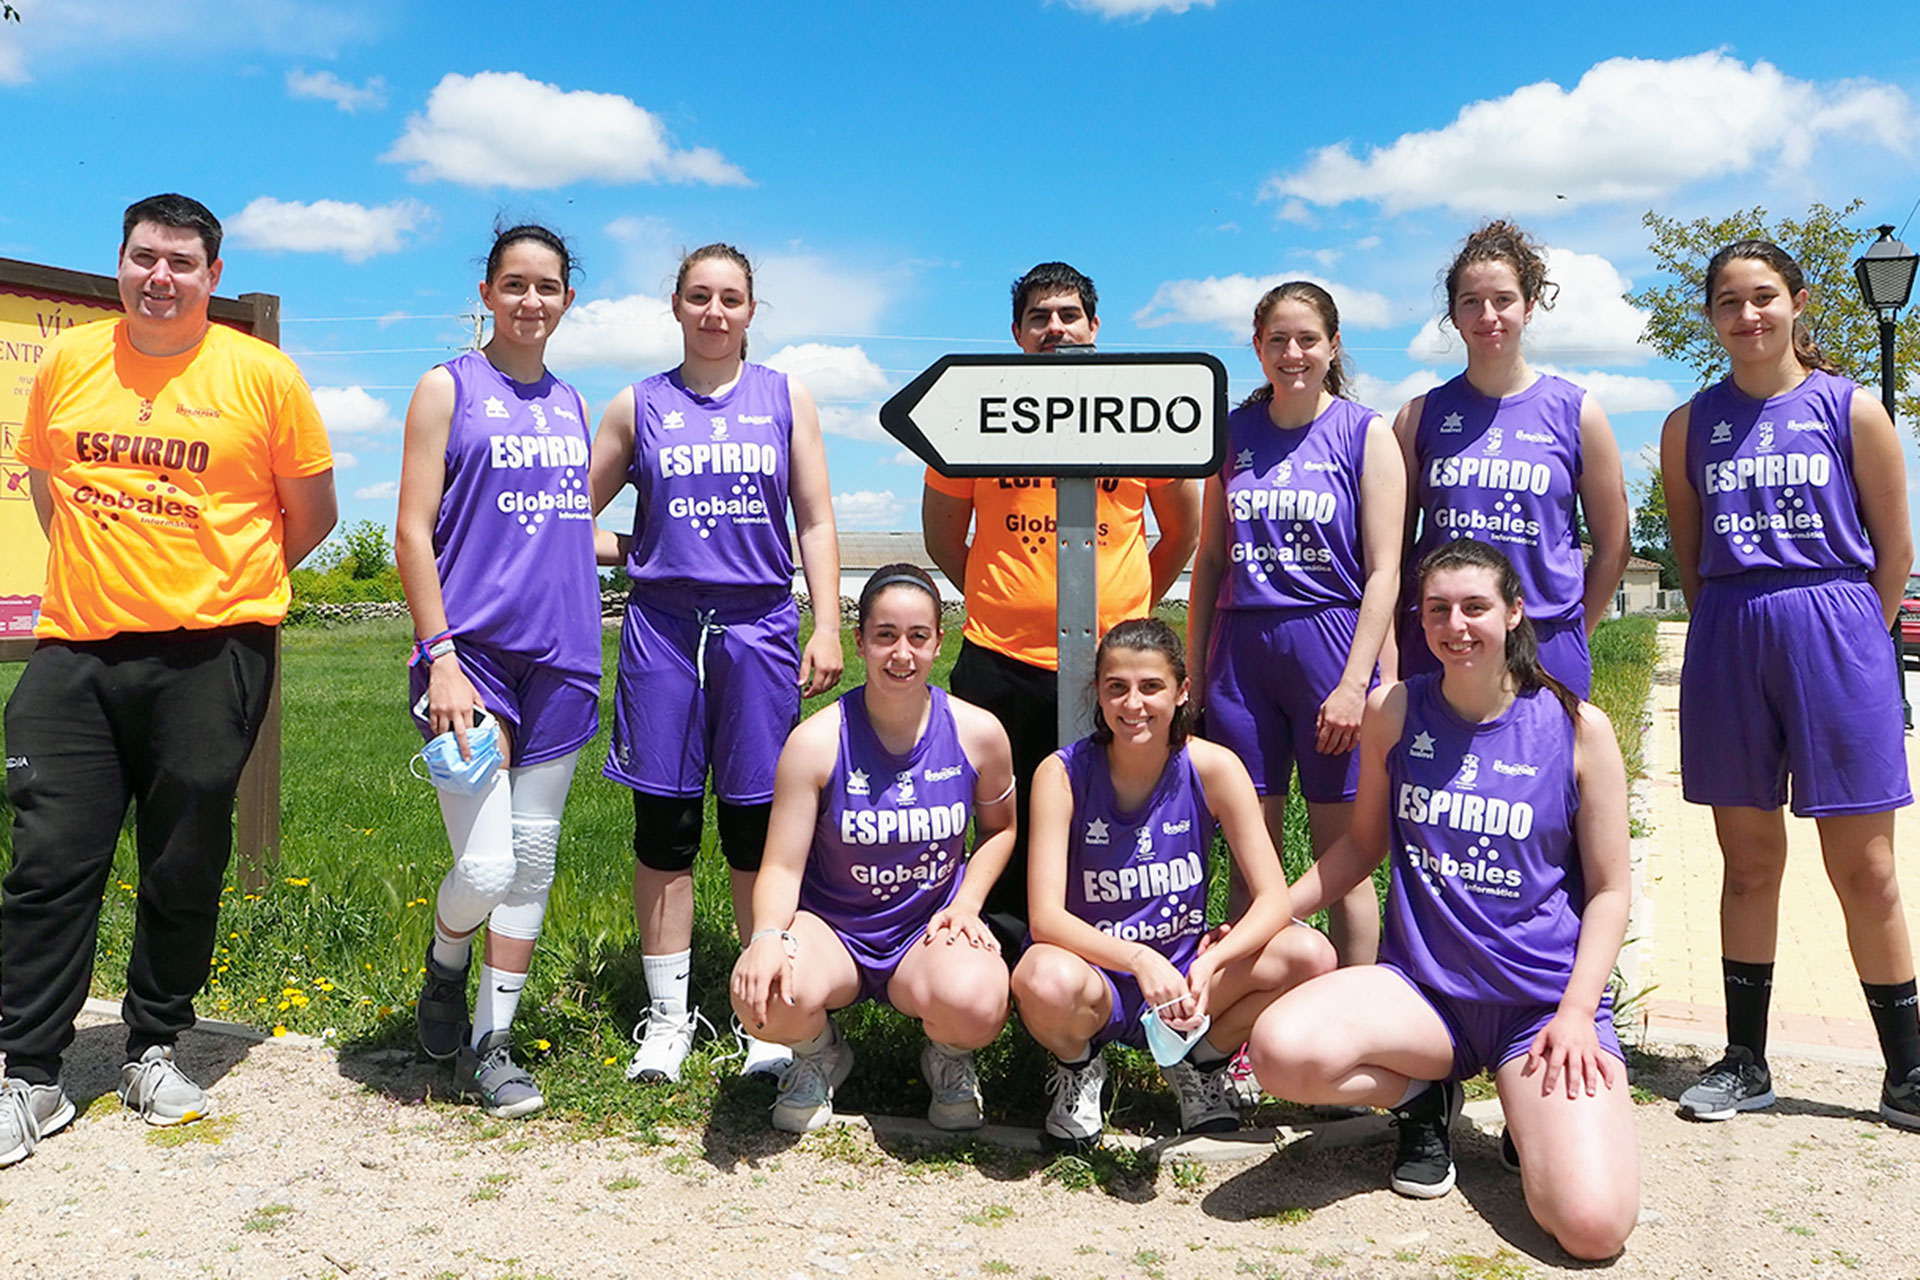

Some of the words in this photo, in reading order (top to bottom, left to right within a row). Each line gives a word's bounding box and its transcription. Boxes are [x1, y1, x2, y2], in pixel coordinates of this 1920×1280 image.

[980, 396, 1201, 434] ESPIRDO
[76, 431, 209, 473] ESPIRDO
[659, 442, 777, 479] ESPIRDO
[1430, 457, 1551, 496] ESPIRDO
[1705, 453, 1830, 495] ESPIRDO
[73, 485, 200, 519] Globales
[497, 489, 592, 513] Globale
[1434, 508, 1540, 536] Globales
[1713, 509, 1824, 534] Globales
[1231, 542, 1332, 563] Globales
[841, 801, 966, 845] ESPIRDO
[1398, 783, 1534, 840] ESPIRDO
[850, 858, 956, 885] Globales
[1083, 851, 1204, 903] ESPIRDO
[1405, 844, 1523, 887] Globales
